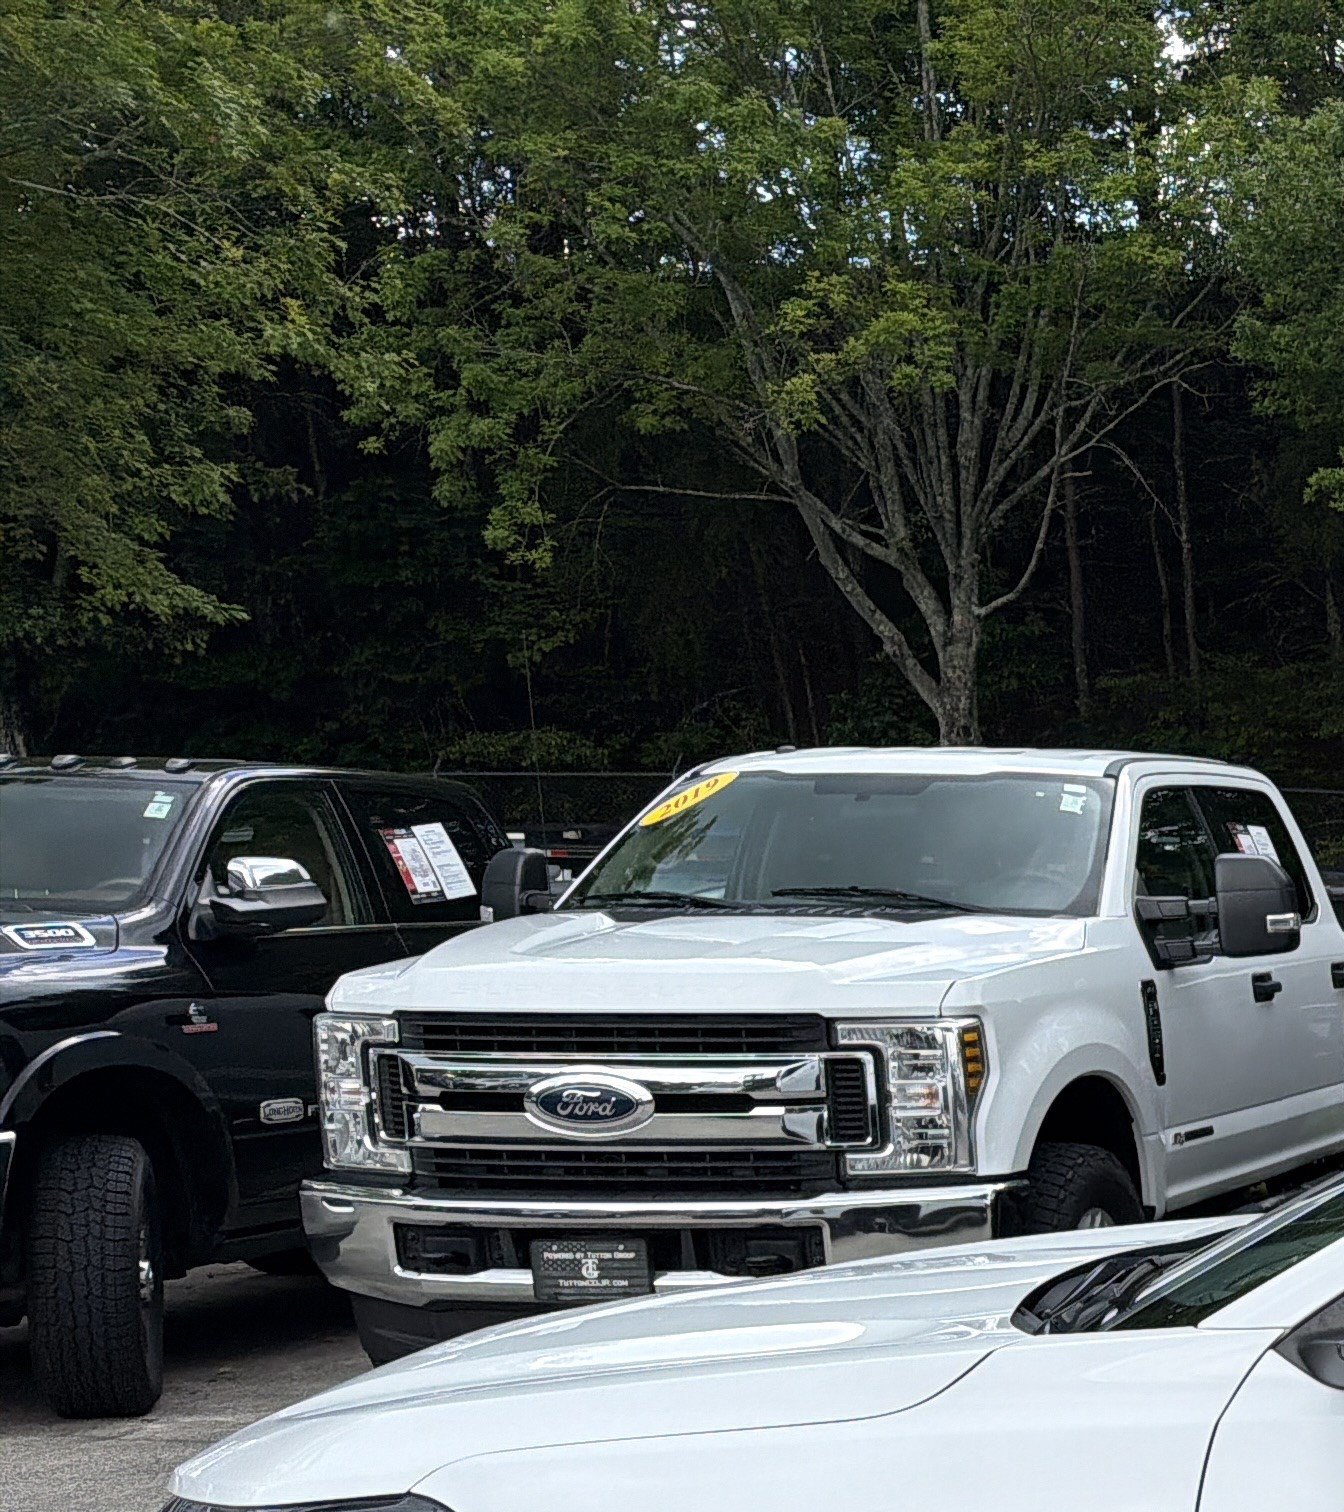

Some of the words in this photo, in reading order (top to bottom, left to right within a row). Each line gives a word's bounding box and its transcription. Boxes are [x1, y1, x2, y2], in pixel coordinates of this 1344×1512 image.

[660, 778, 719, 818] 2019
[21, 928, 75, 938] 3500
[556, 1089, 617, 1116] Ford
